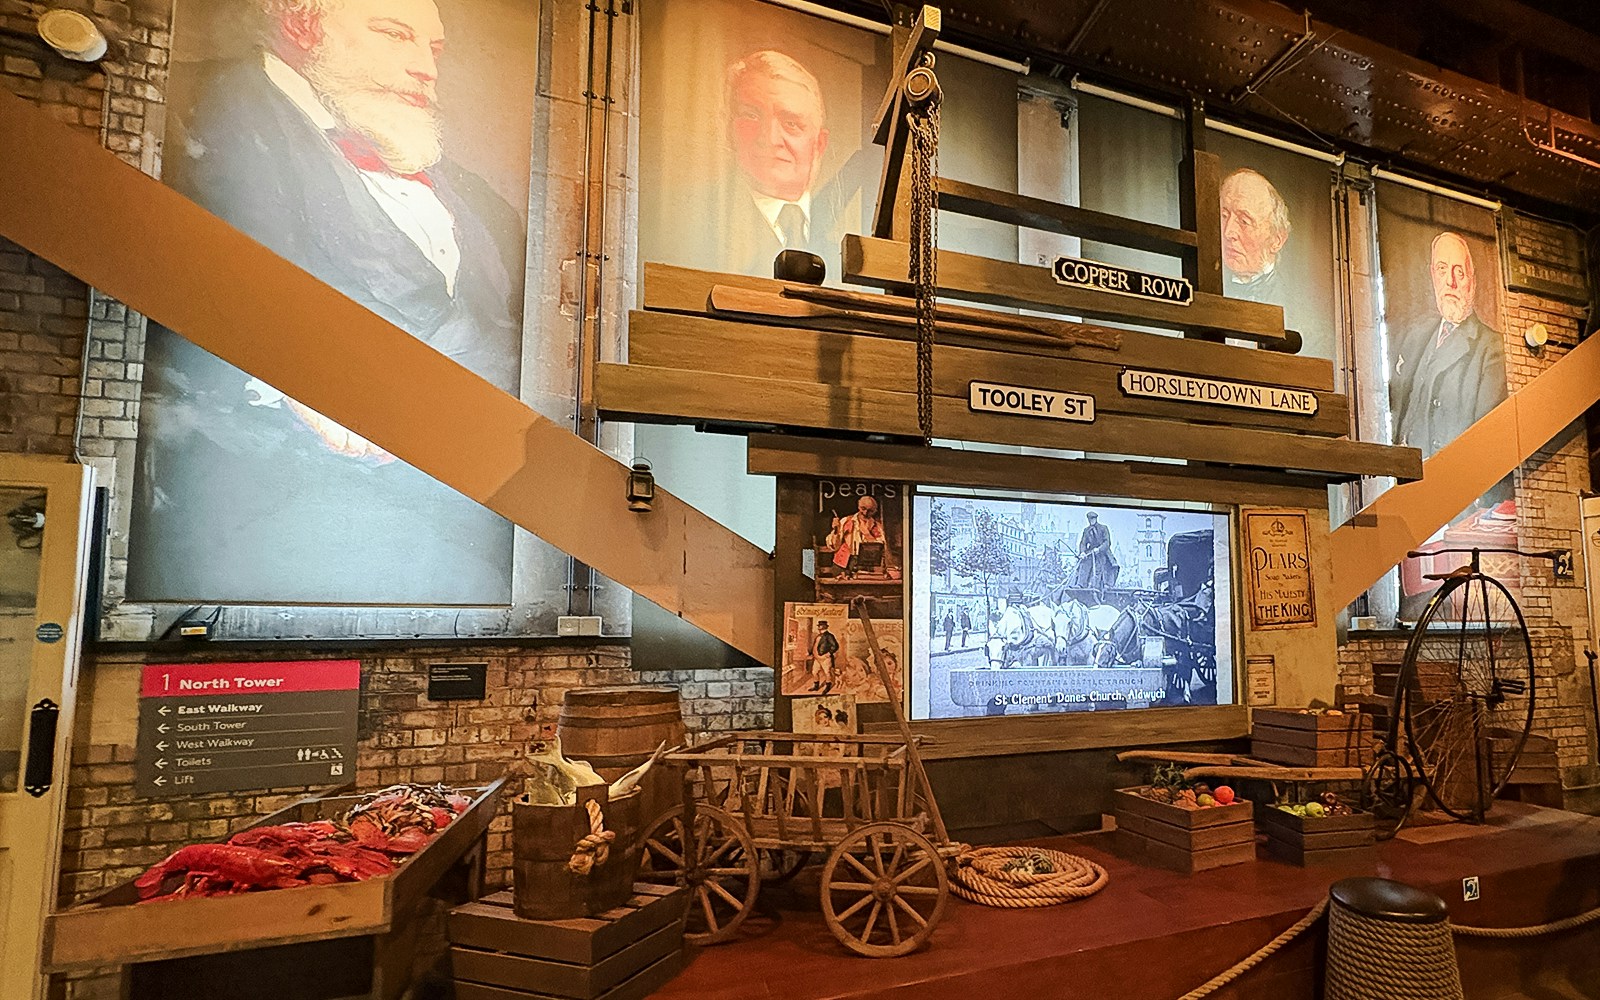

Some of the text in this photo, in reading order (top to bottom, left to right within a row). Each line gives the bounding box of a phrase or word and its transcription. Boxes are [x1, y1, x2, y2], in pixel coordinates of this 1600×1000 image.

[1061, 261, 1184, 299] COPPER ROW
[1129, 373, 1311, 411] HORSLEYDOWN LANE
[978, 387, 1088, 416] TOOLEY ST
[1258, 602, 1310, 619] THE KING
[162, 673, 284, 691] 1 North Tower
[994, 694, 1008, 706] St
[1011, 692, 1053, 705] Clement
[1055, 691, 1087, 703] Danes
[1127, 687, 1166, 702] Aldwych
[177, 703, 263, 715] East Walkway
[177, 720, 247, 732] South Tower
[176, 737, 255, 749] West Walkway
[175, 756, 212, 767] Toilets
[174, 775, 195, 785] Lift
